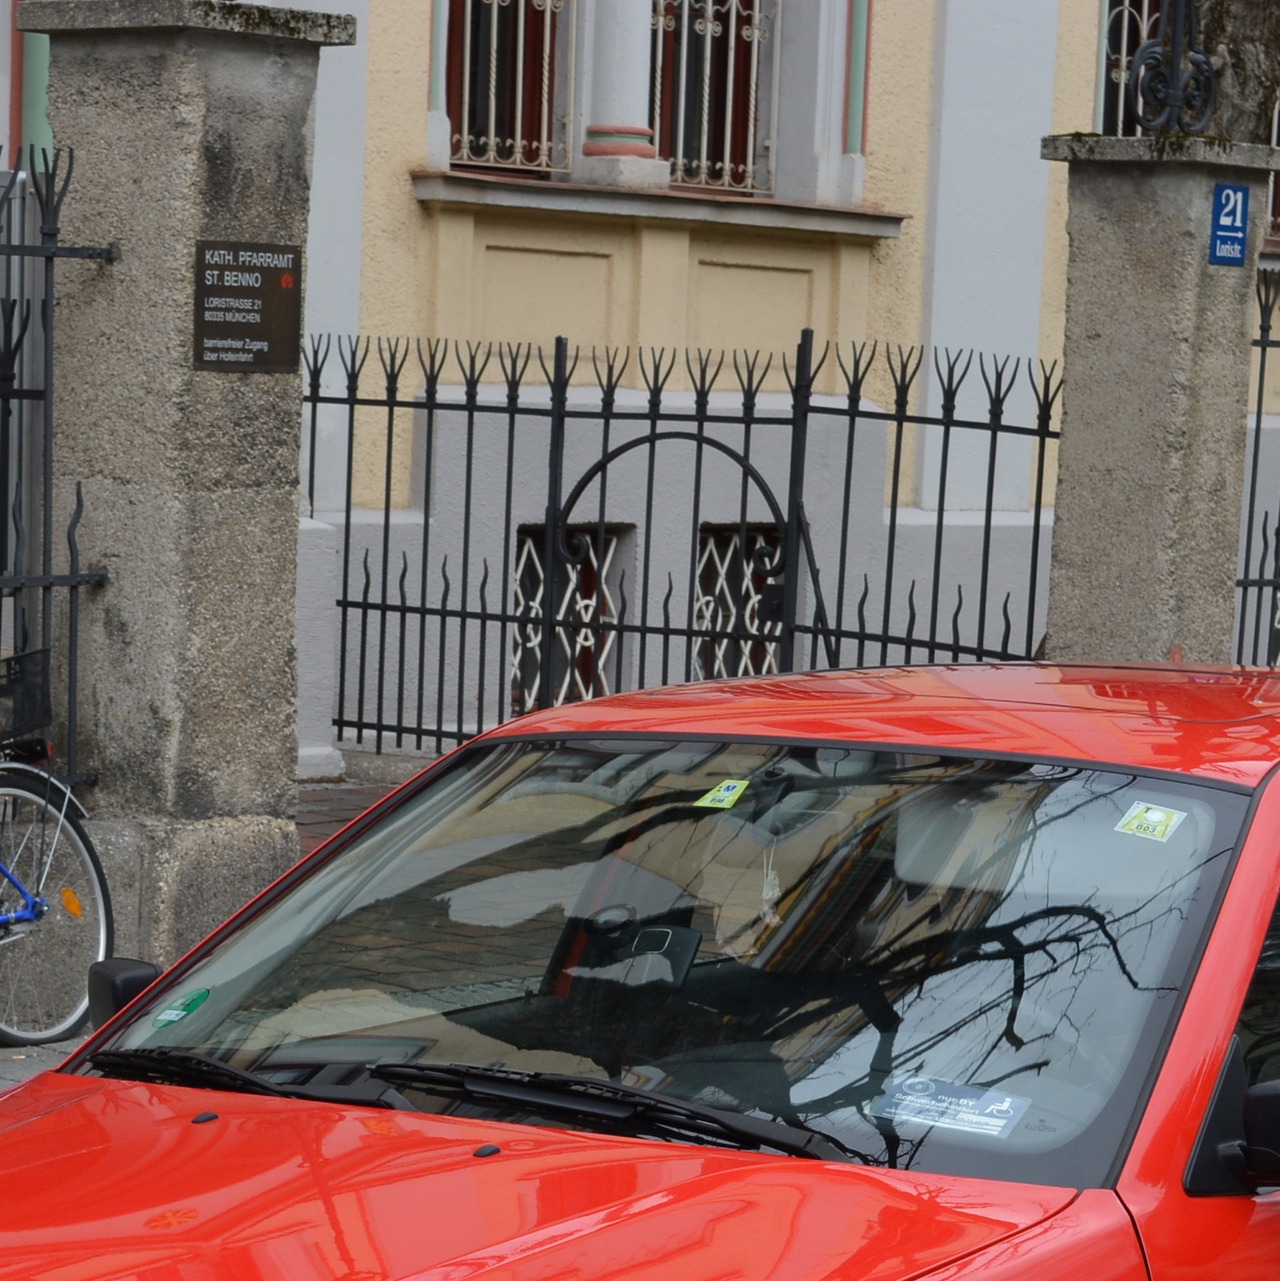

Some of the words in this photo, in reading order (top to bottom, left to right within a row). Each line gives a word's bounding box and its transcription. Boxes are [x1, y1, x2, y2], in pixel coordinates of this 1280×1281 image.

[1219, 189, 1243, 227] 21
[205, 250, 236, 265] KATH.
[238, 252, 294, 269] PFARRAMT
[205, 271, 222, 286] ST.
[224, 272, 261, 287] BENNO
[204, 297, 252, 309] LORISTRASSE
[253, 299, 262, 310] 21
[225, 310, 261, 323] MÜNCHEN
[244, 338, 268, 352] Zugang
